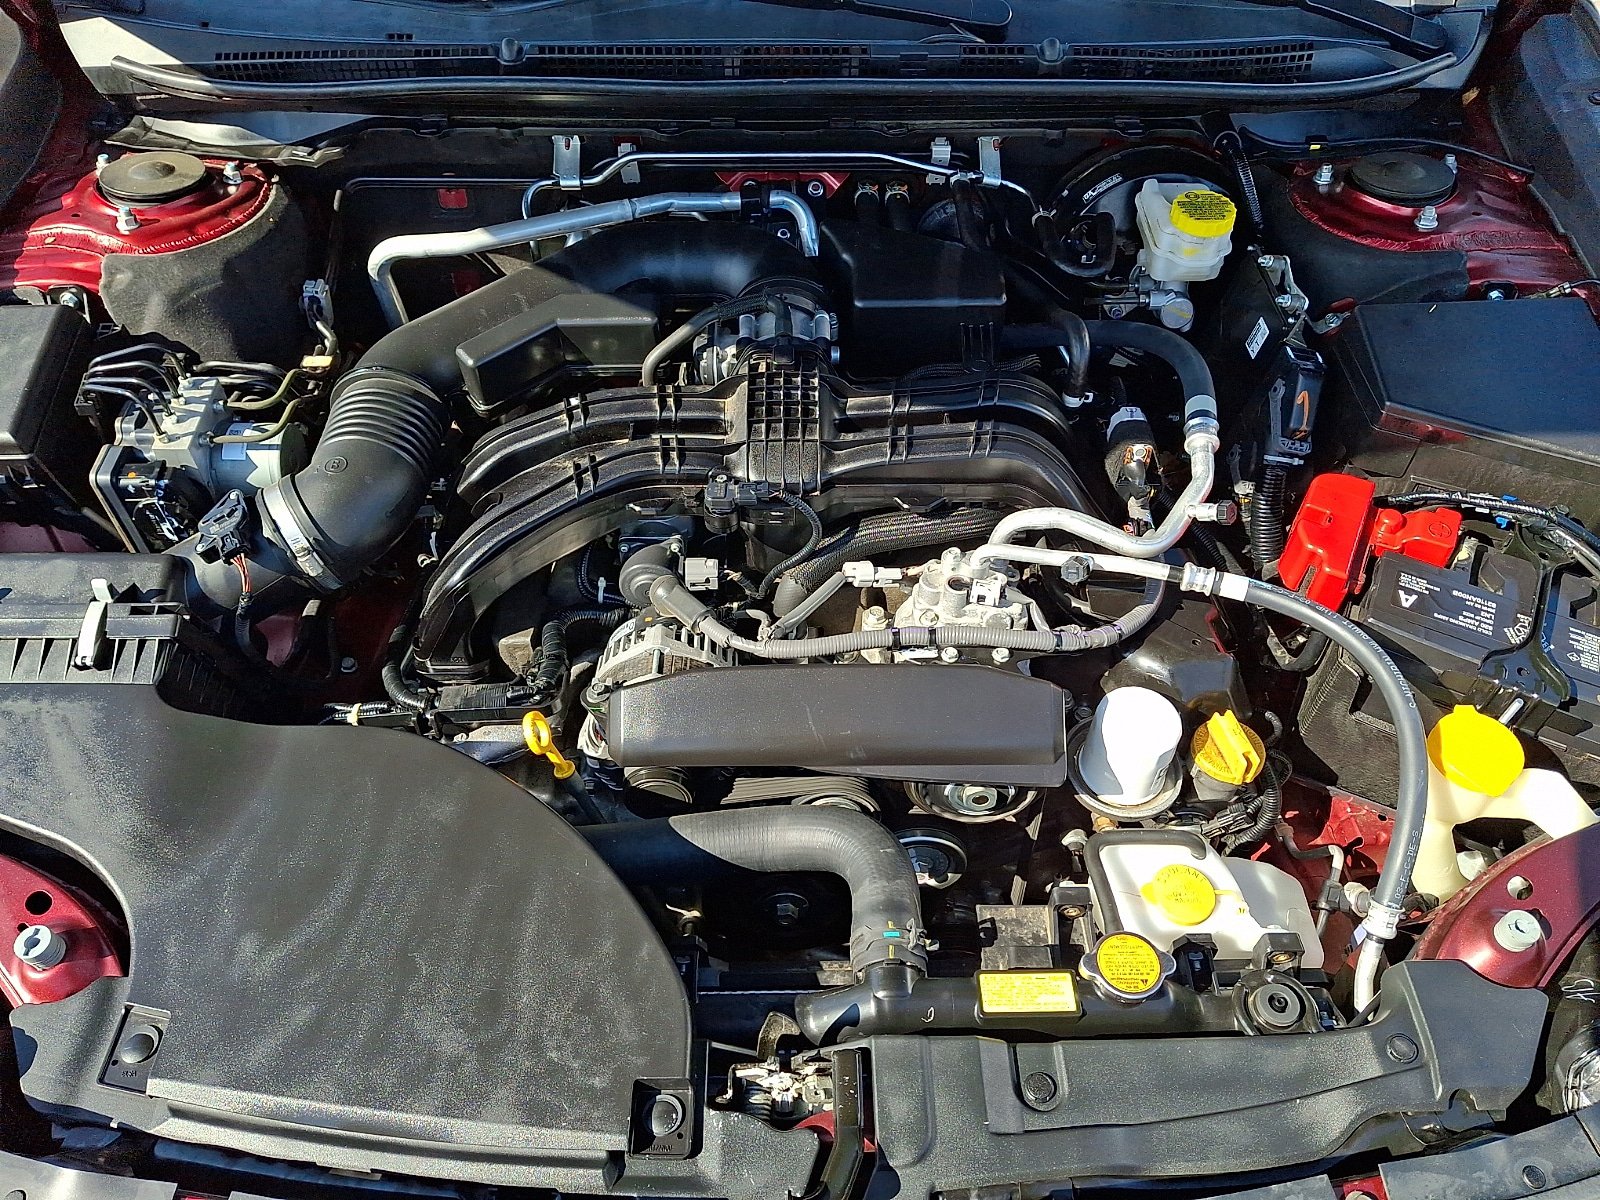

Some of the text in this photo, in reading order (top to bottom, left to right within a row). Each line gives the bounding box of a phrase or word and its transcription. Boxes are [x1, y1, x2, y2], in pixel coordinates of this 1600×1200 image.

[329, 459, 341, 470] B
[1398, 589, 1418, 608] A
[1459, 616, 1479, 626] AMPS
[1394, 829, 1419, 899] 03-F-C-DE-S
